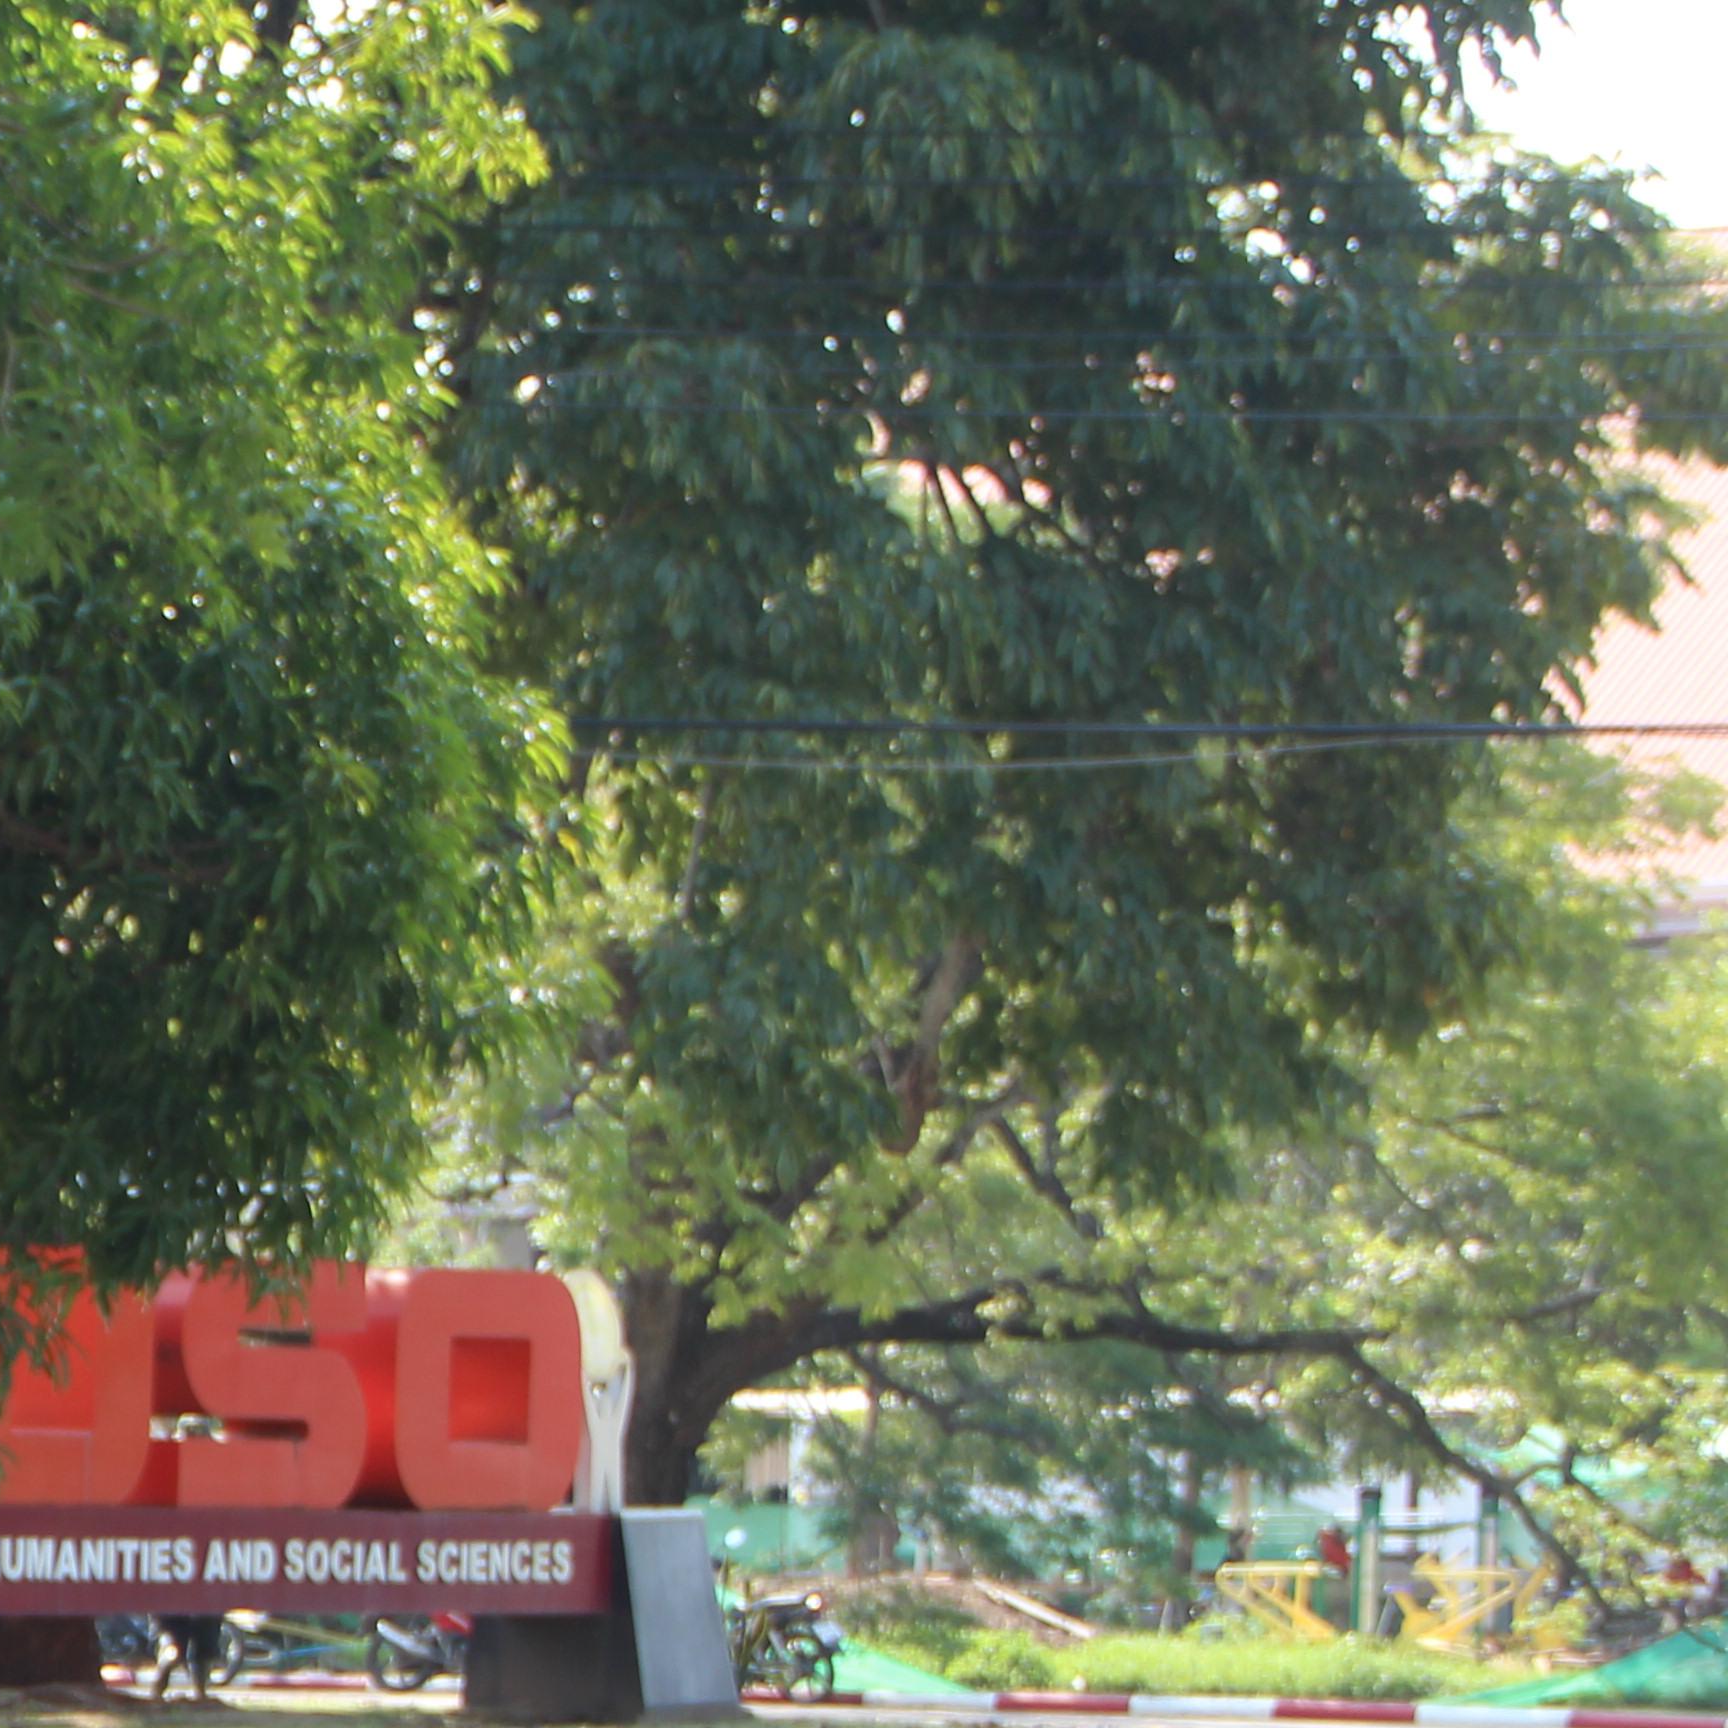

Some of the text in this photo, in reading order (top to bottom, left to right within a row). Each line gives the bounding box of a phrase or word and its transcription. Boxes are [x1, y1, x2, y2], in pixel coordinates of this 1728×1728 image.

[204, 1539, 276, 1582] AND
[284, 1539, 407, 1582] SOCIAL
[416, 1541, 573, 1583] SCIENCES
